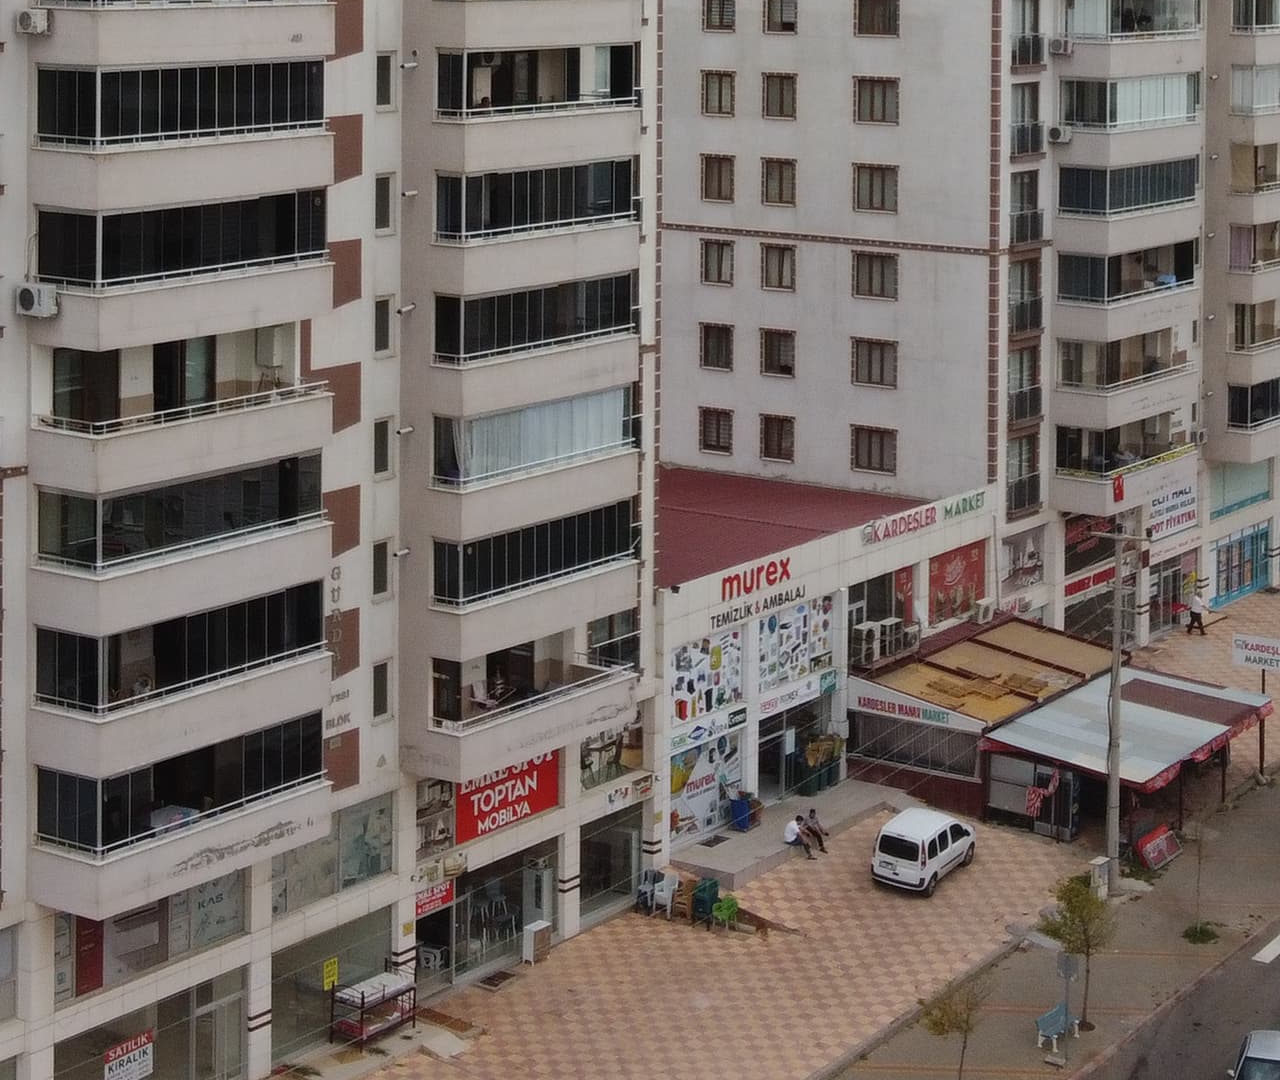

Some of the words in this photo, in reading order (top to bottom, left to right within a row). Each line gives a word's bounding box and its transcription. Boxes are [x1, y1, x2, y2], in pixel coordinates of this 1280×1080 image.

[944, 490, 986, 520] MARKET
[1151, 521, 1164, 533] POT
[721, 556, 791, 601] murex
[710, 604, 754, 630] TEMİZLİK
[754, 601, 761, 614] &
[762, 584, 806, 612] AMBALAJ
[1244, 655, 1280, 667] MARKET
[922, 708, 950, 724] MARKET
[471, 770, 538, 816] TOPTAN
[686, 773, 716, 794] murex
[478, 800, 531, 834] MOBİLYA
[108, 1032, 149, 1061] SATILIK
